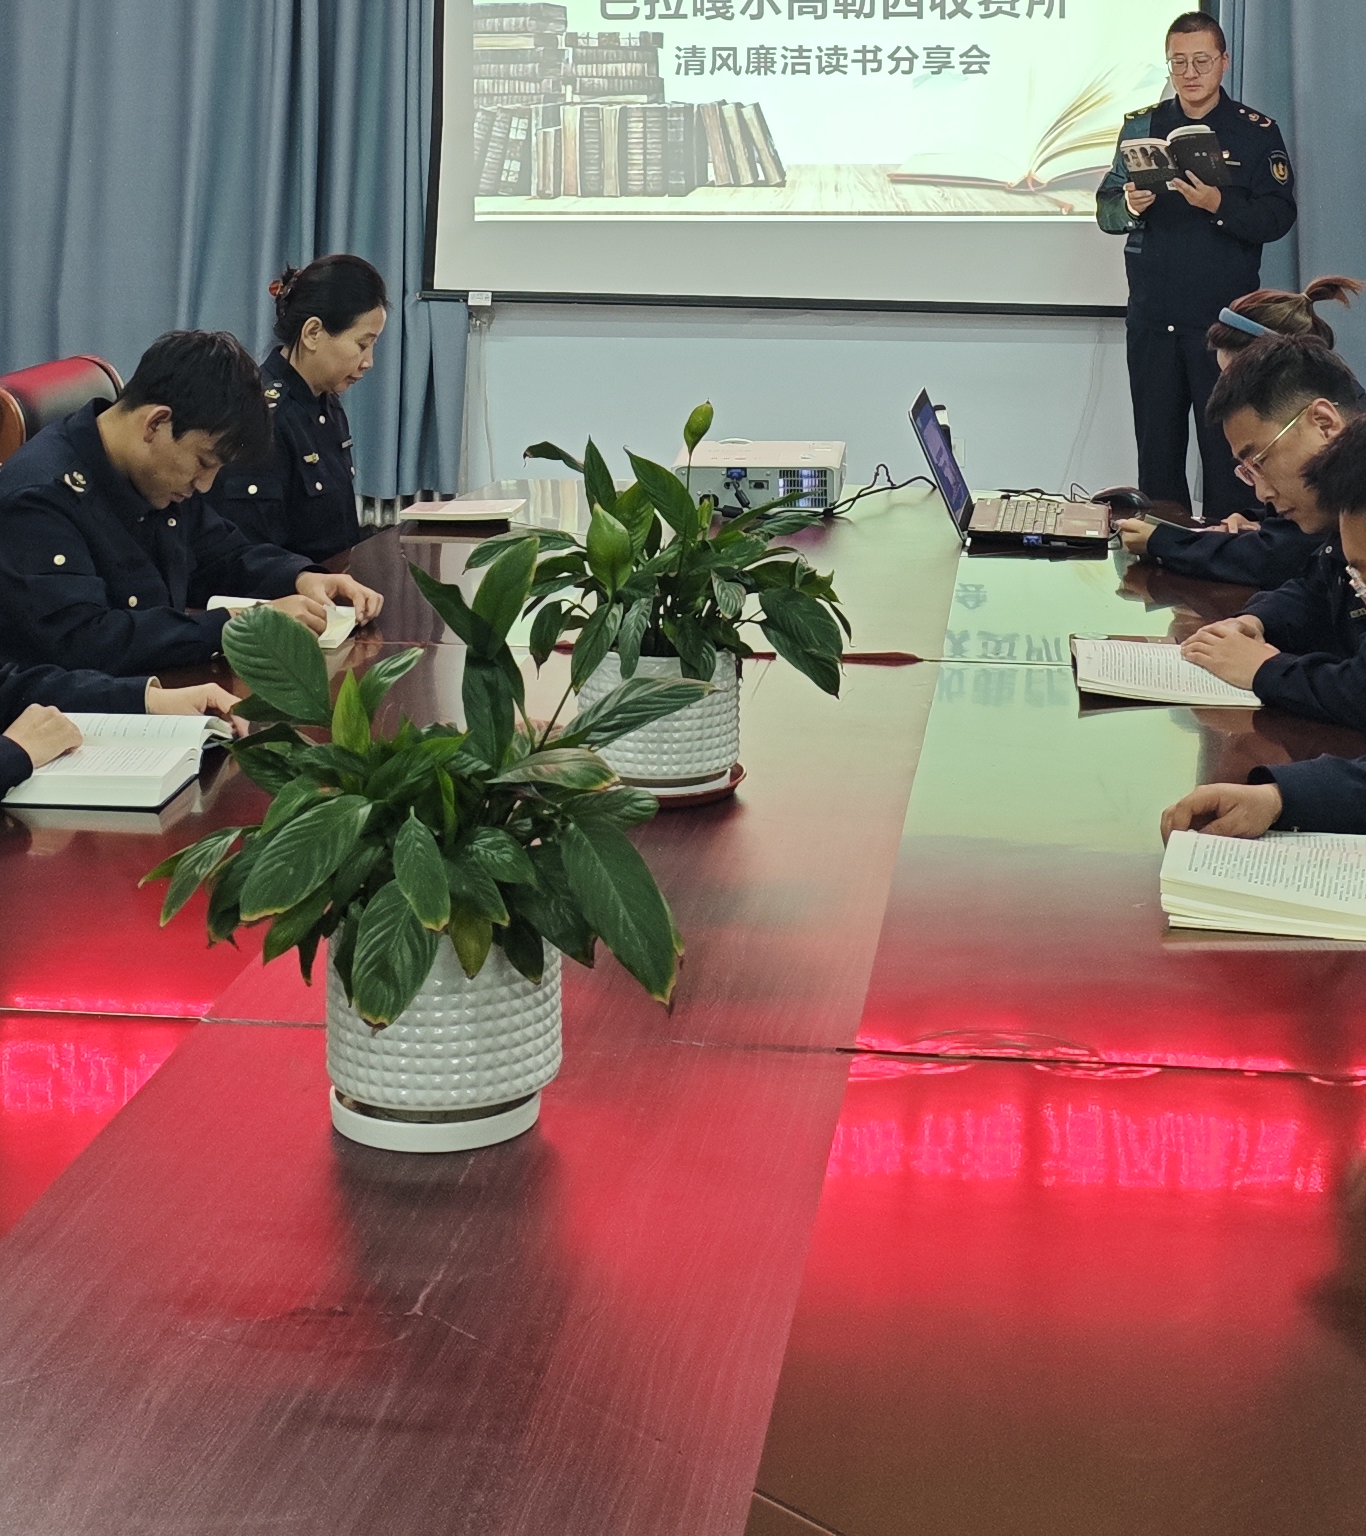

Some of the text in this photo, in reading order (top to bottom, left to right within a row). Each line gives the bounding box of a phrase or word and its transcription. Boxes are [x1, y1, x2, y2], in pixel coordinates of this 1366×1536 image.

[673, 43, 991, 77] 清风廉洁读书分享会
